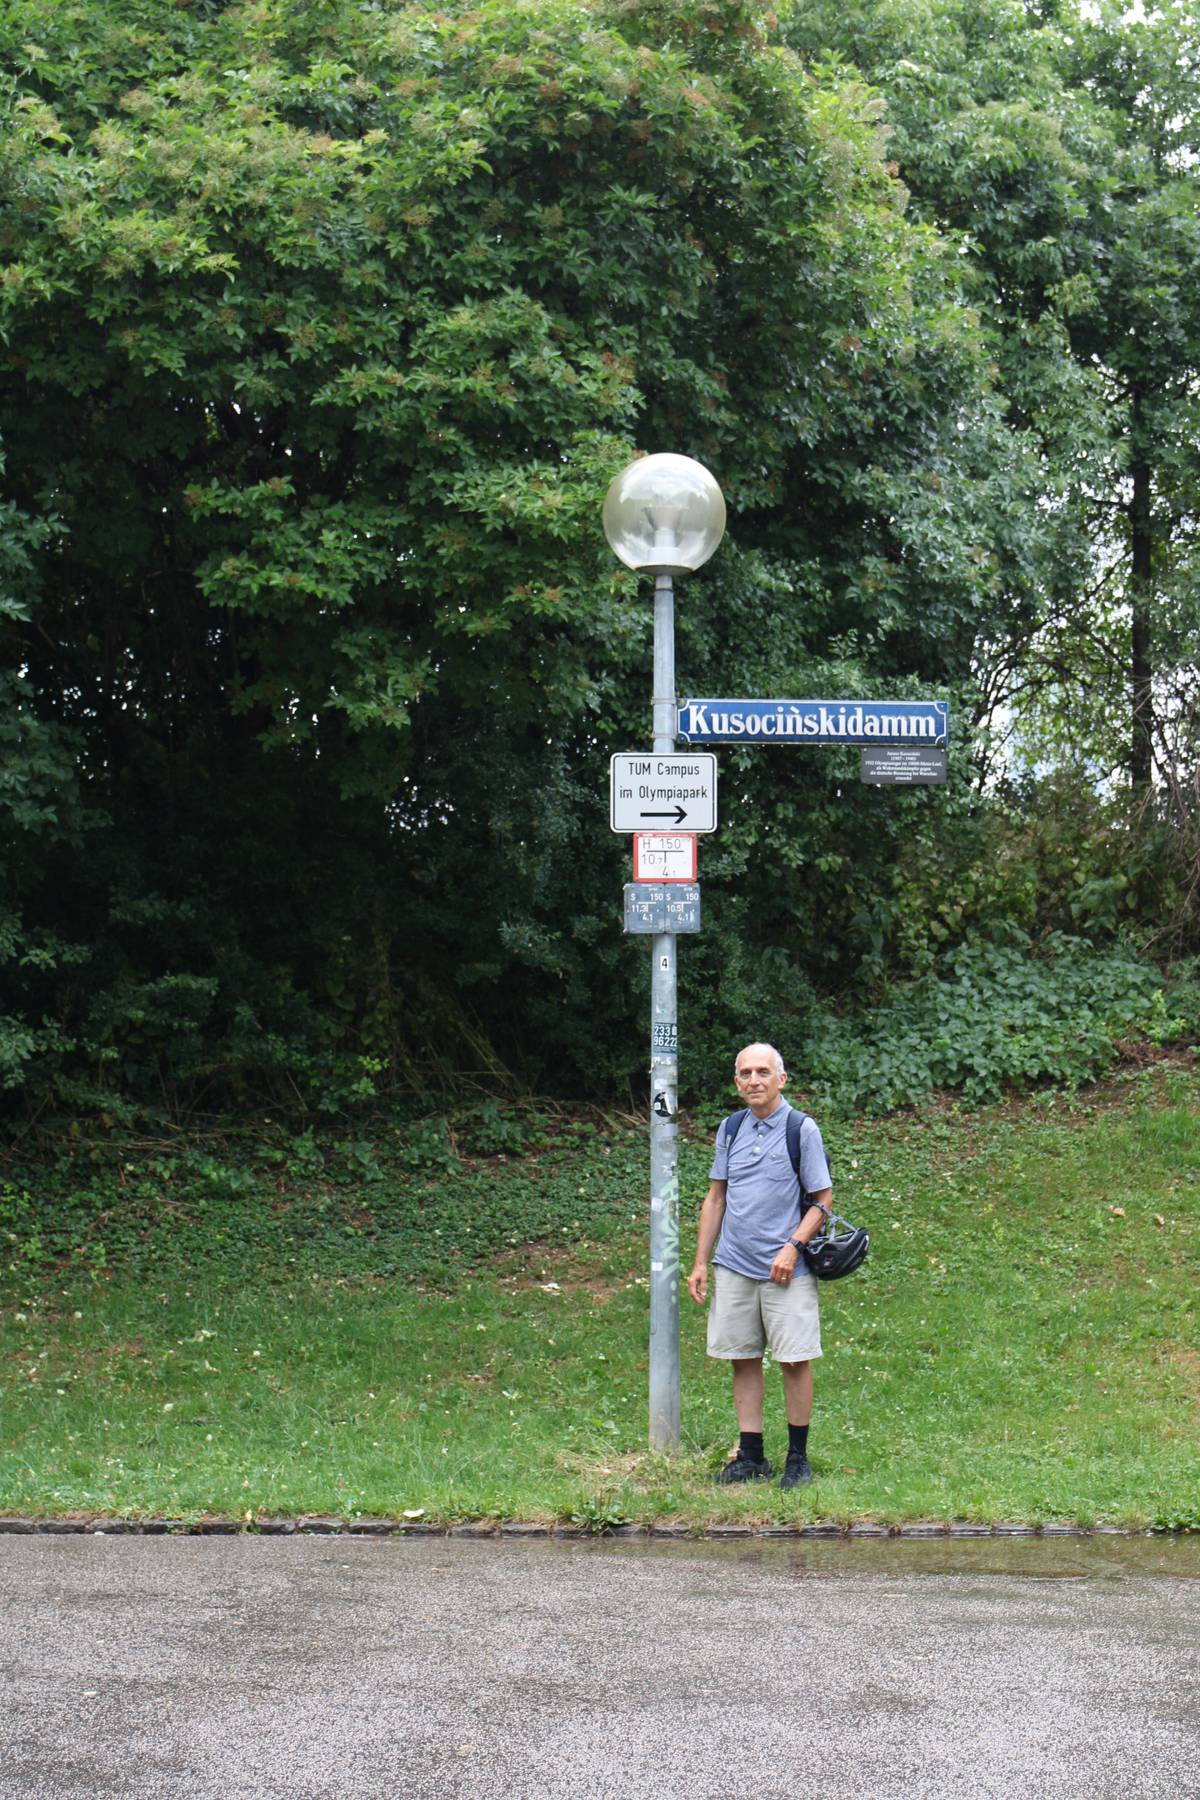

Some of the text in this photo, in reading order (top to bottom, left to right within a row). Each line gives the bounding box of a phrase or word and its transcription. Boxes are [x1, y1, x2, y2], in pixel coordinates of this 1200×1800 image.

[628, 762, 700, 778] TUM Campus
[619, 785, 708, 802] im Olympiapark
[642, 838, 681, 849] H 150
[650, 893, 664, 901] 150
[685, 893, 699, 901] 150
[661, 958, 668, 969] 4
